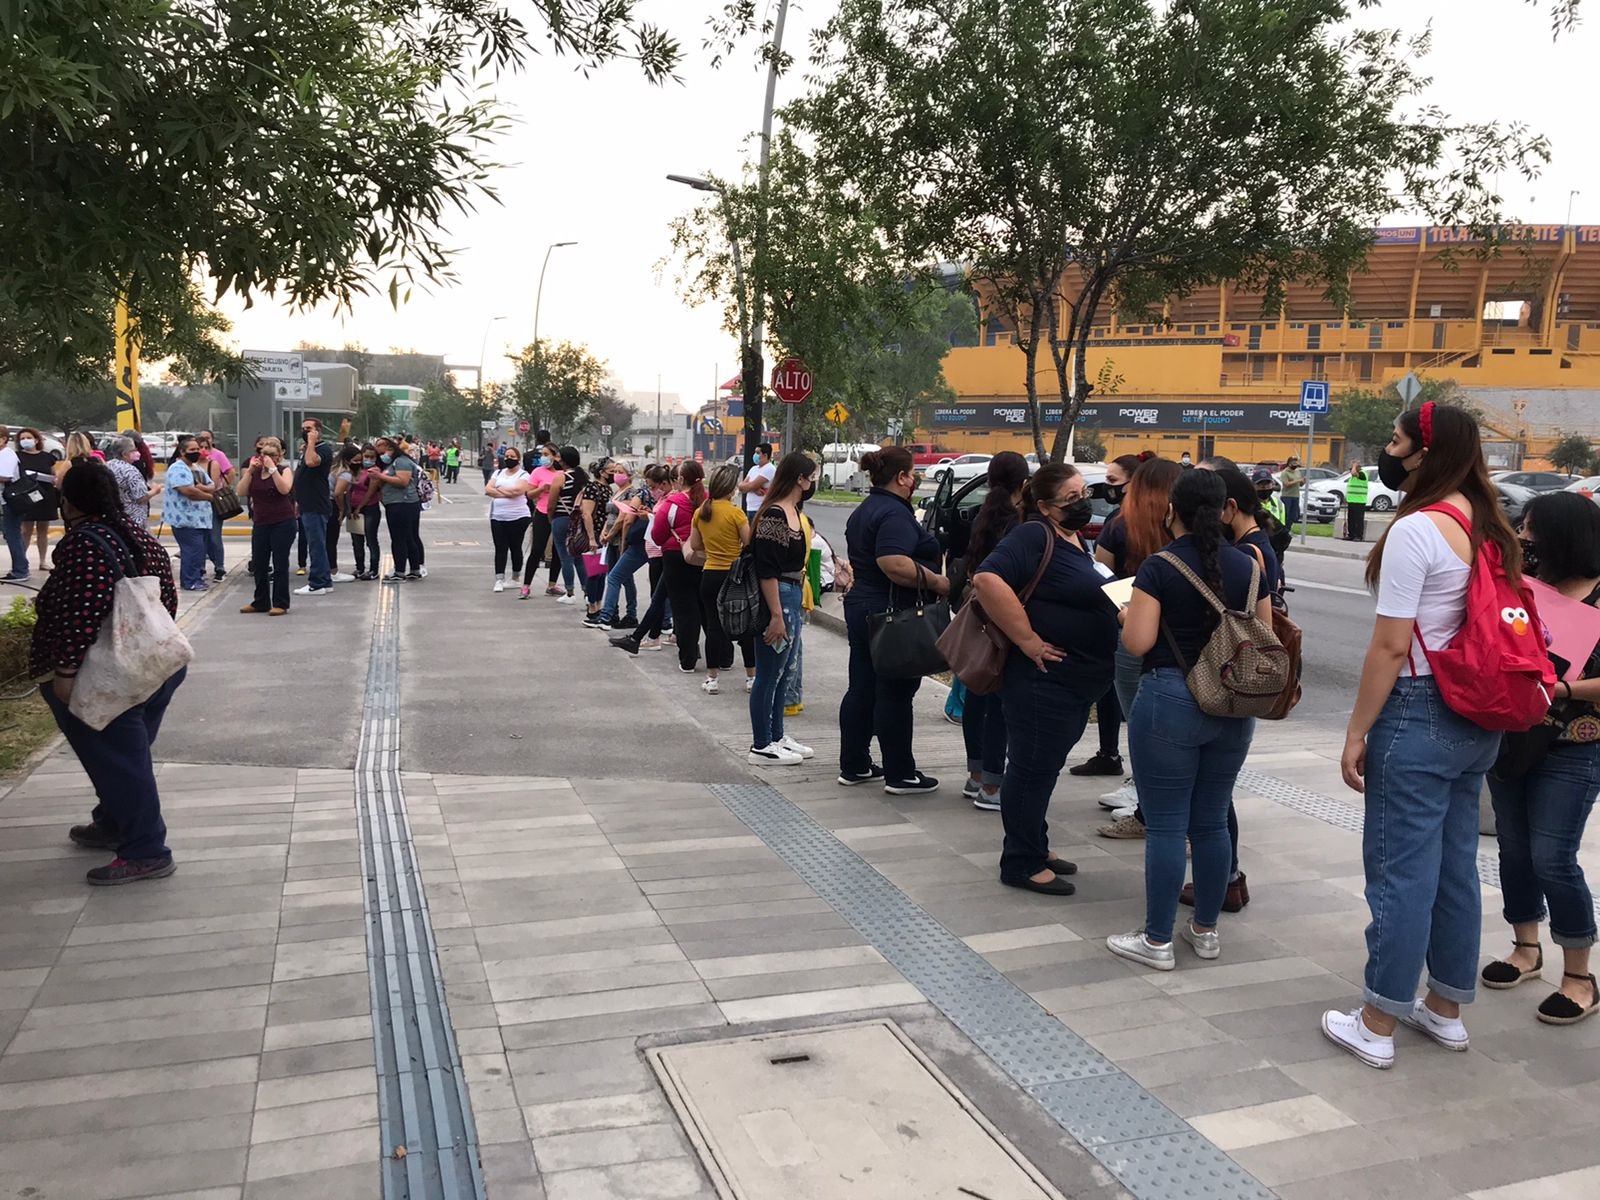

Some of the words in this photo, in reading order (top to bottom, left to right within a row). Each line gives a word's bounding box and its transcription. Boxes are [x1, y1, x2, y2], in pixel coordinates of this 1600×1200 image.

[775, 371, 810, 390] ALTO
[1119, 409, 1159, 417] POWER
[1134, 416, 1158, 424] ADE
